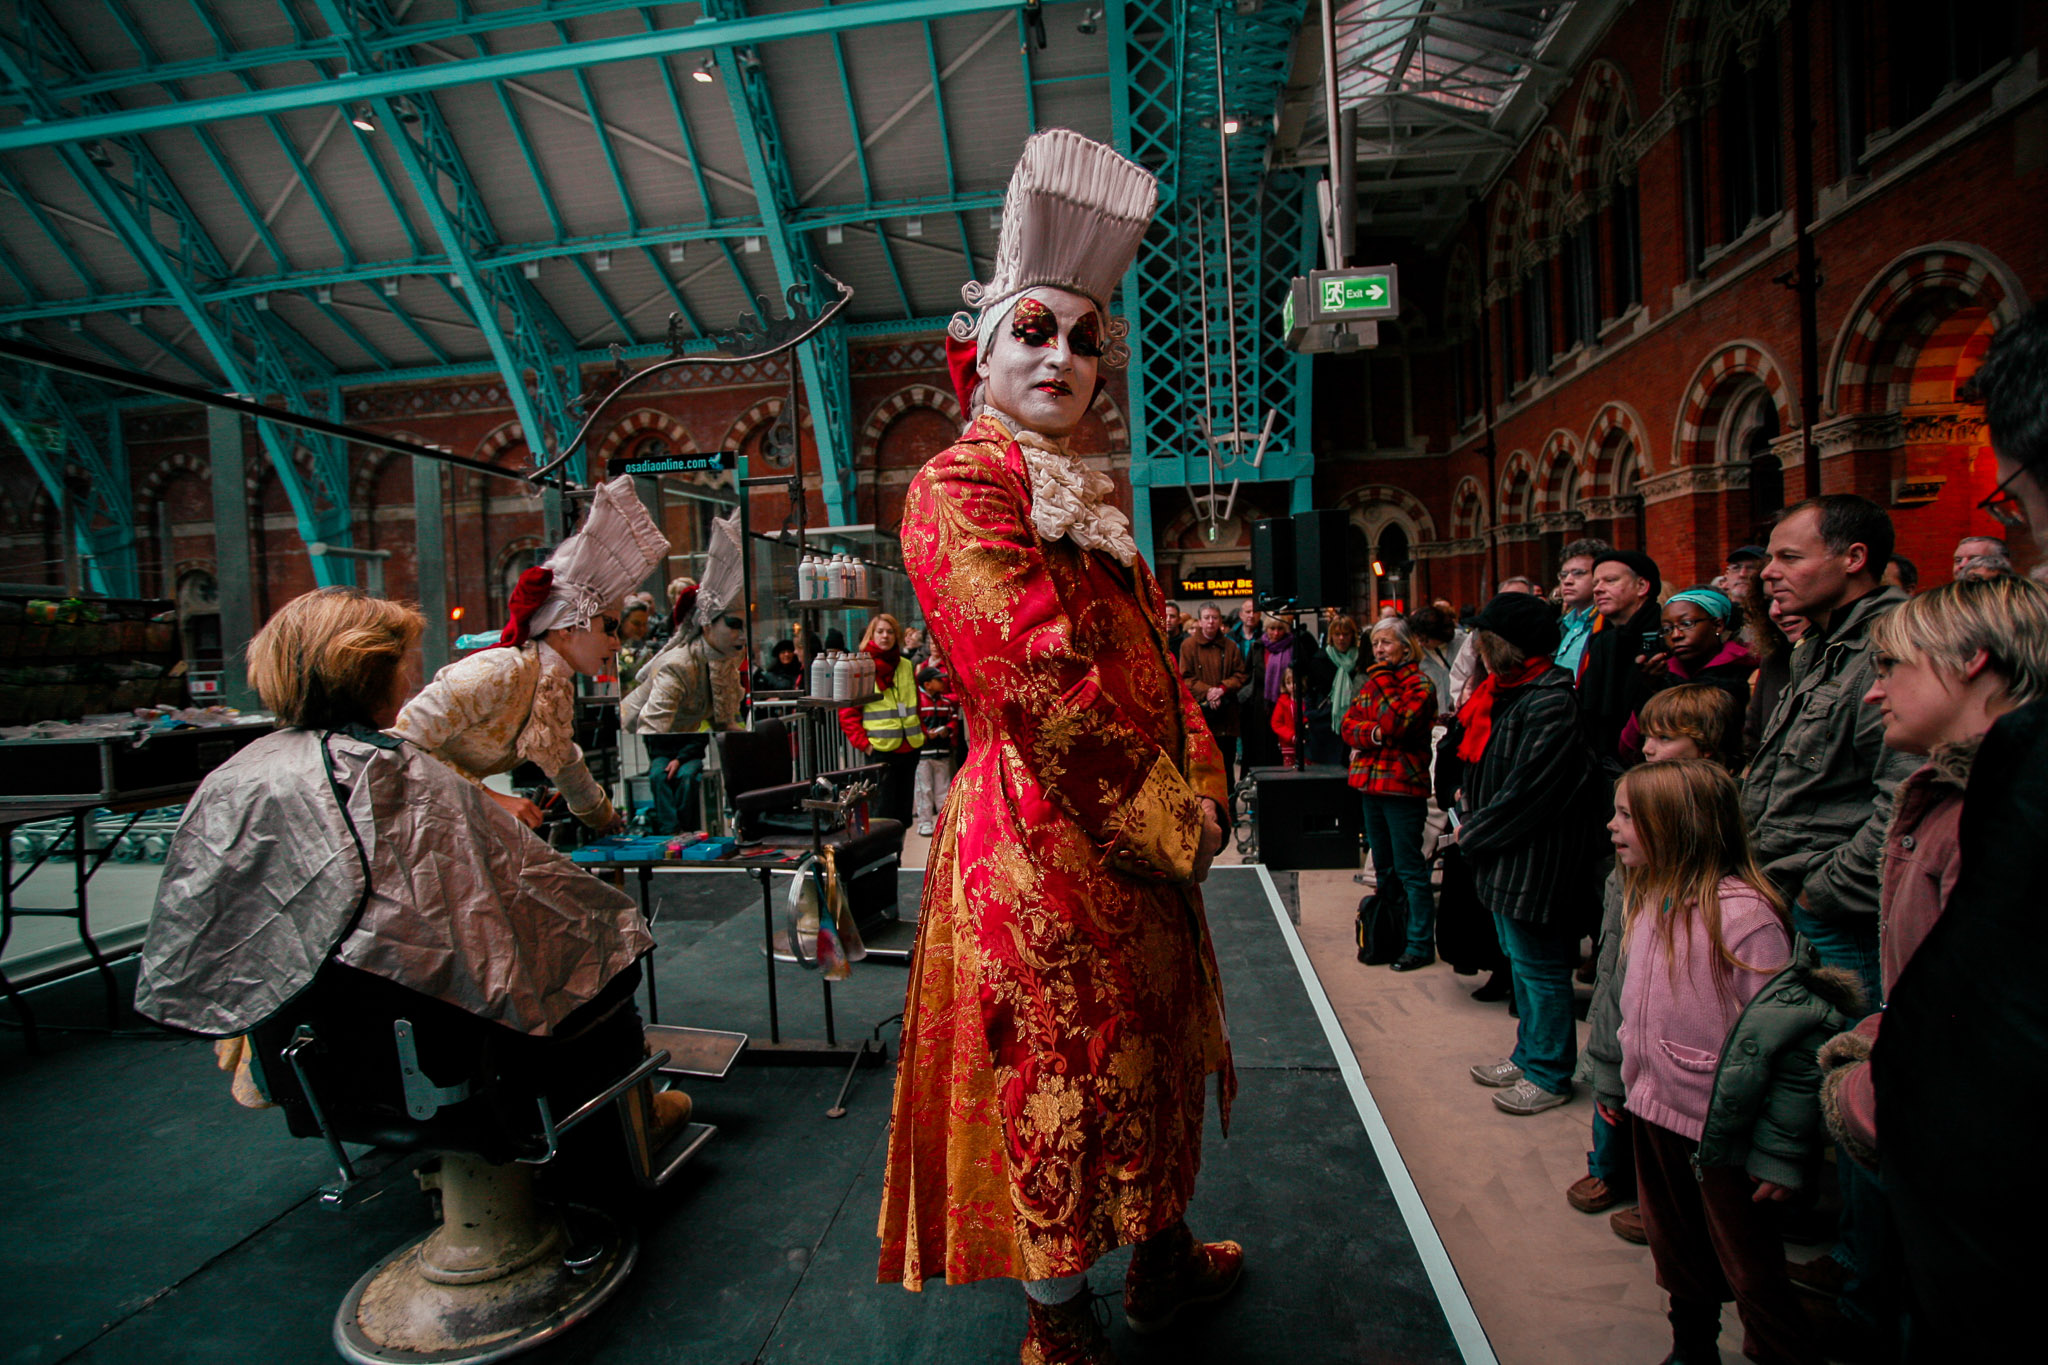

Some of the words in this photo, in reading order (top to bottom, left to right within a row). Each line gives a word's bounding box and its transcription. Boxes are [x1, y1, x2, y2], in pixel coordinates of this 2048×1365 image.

[1346, 289, 1363, 299] Exit
[625, 458, 707, 473] osadiaonline.com
[1181, 581, 1205, 591] THE
[1207, 580, 1234, 589] BABY
